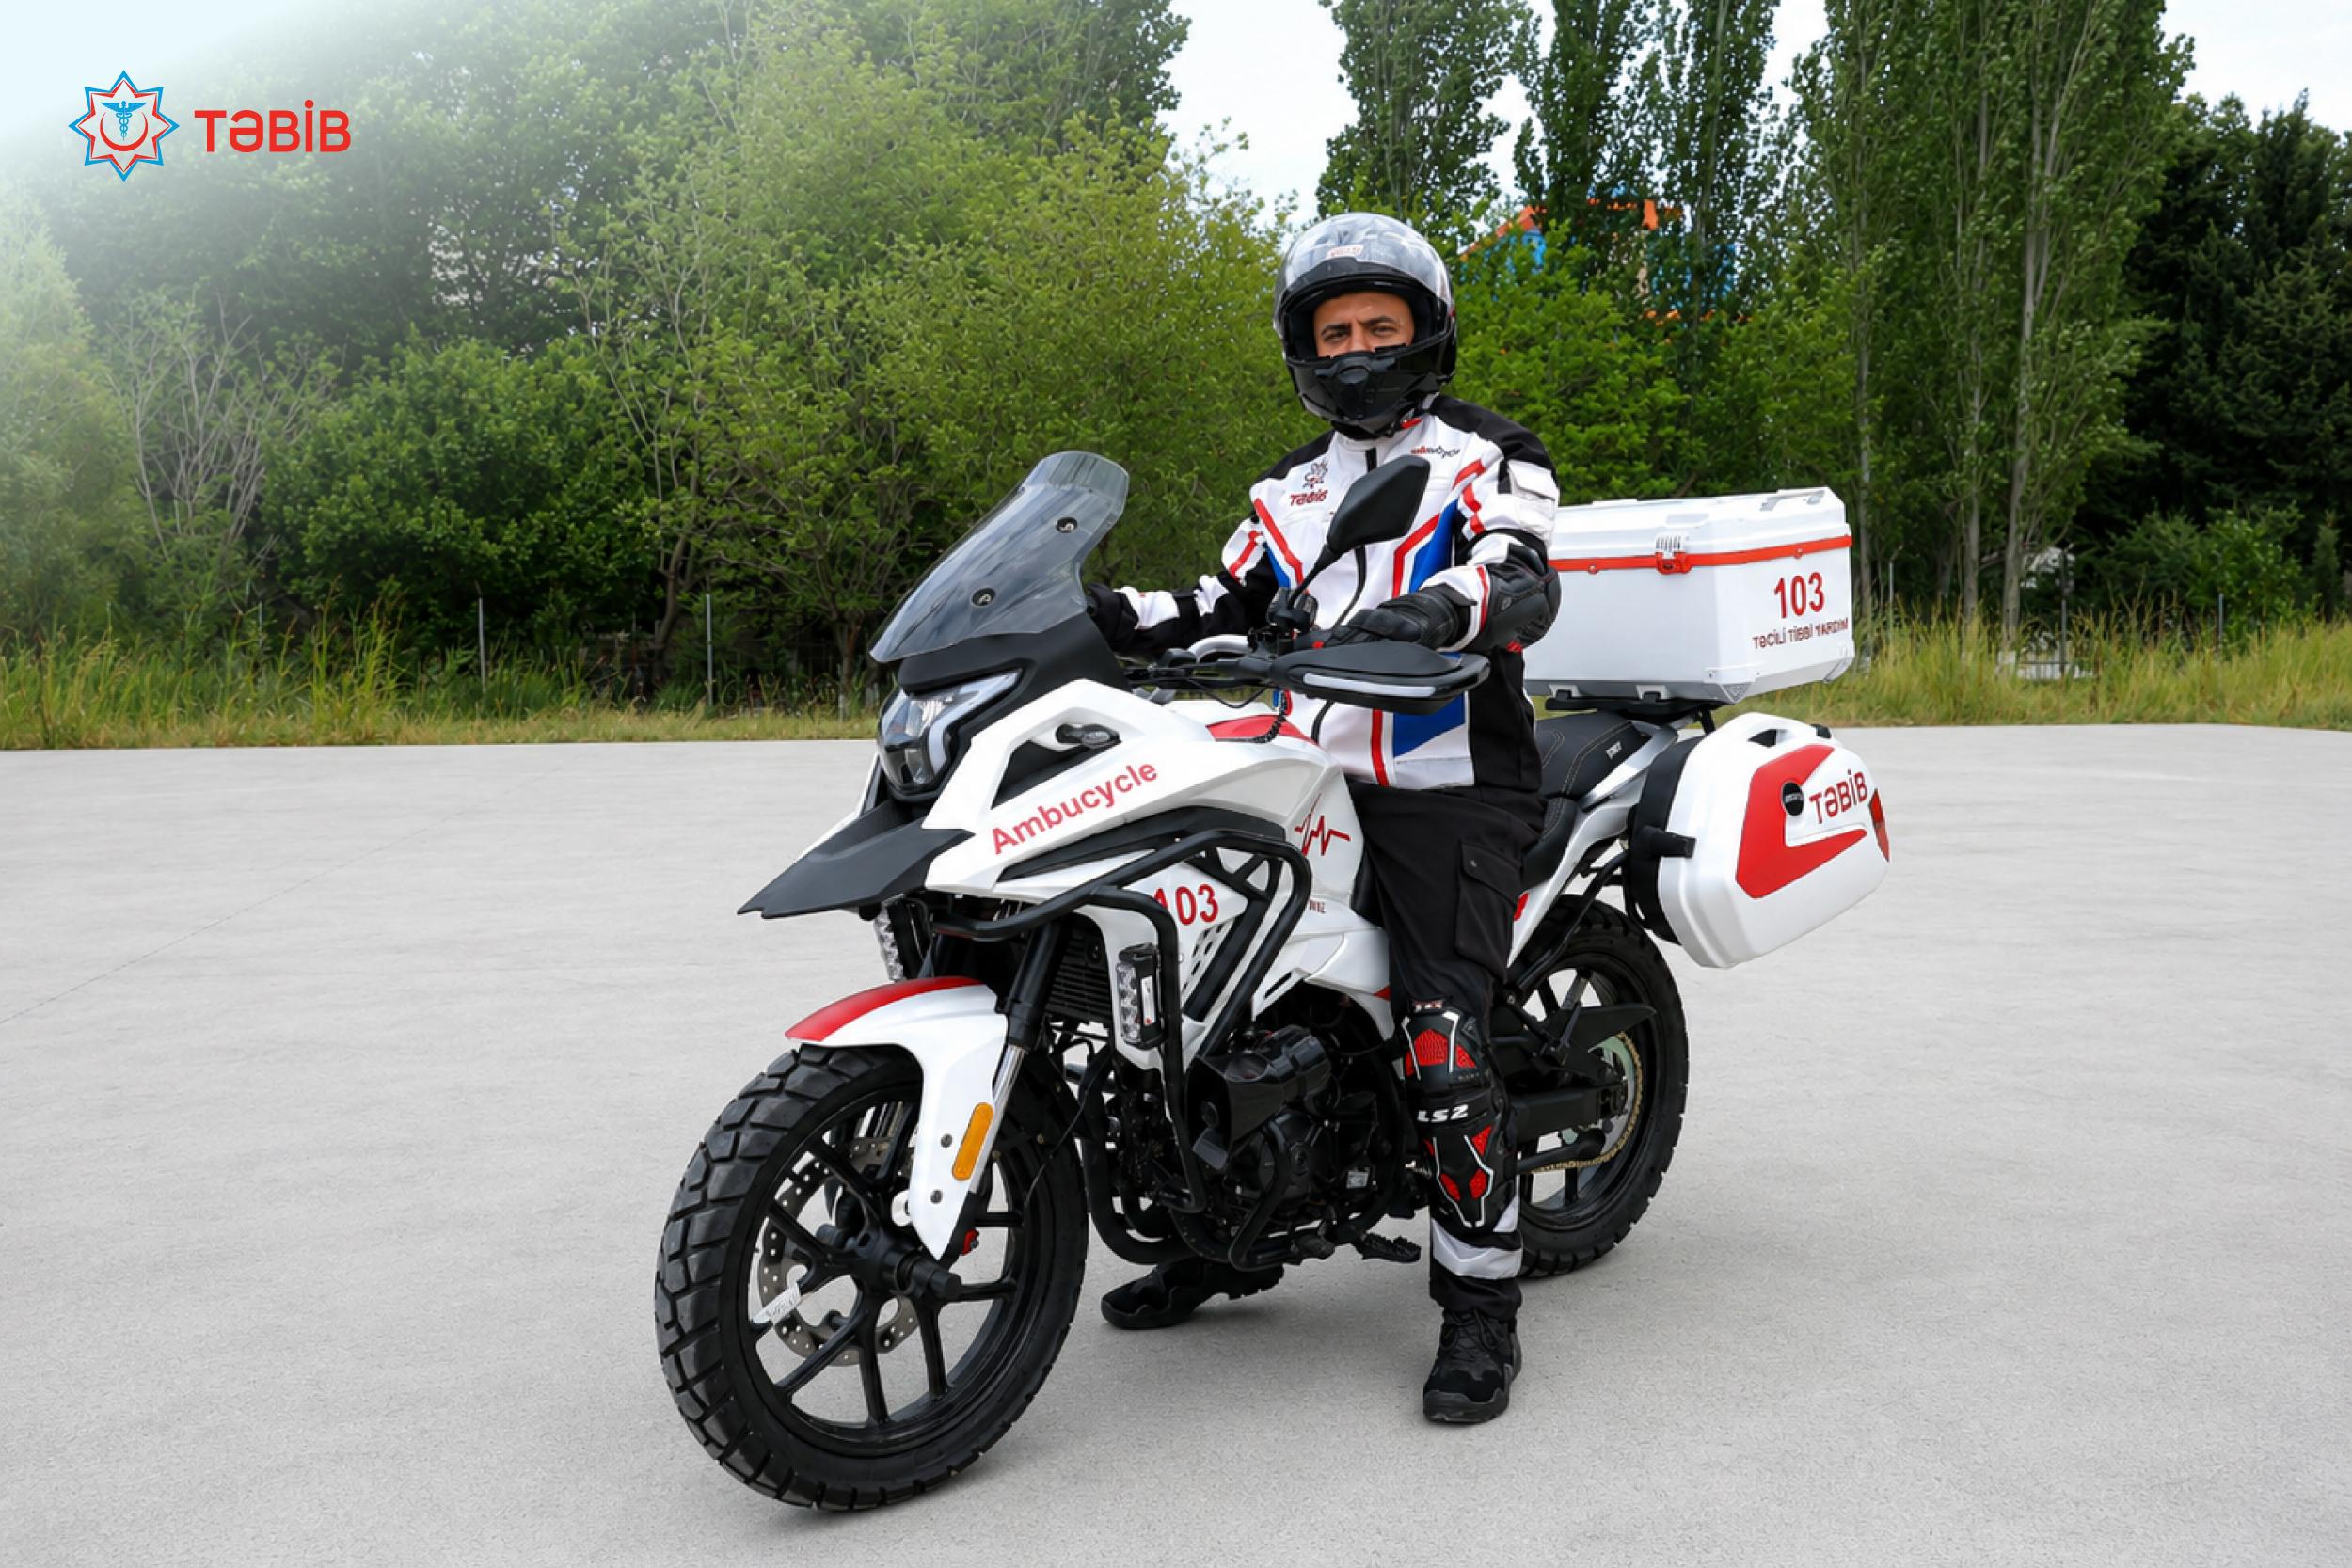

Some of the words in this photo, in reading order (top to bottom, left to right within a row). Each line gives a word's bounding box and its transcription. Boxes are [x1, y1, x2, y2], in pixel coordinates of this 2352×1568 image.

[1774, 571, 1825, 618] 103
[993, 761, 1158, 855] Ambucycle
[1808, 768, 1868, 825] TƏBİB
[1417, 1104, 1469, 1123] LS2
